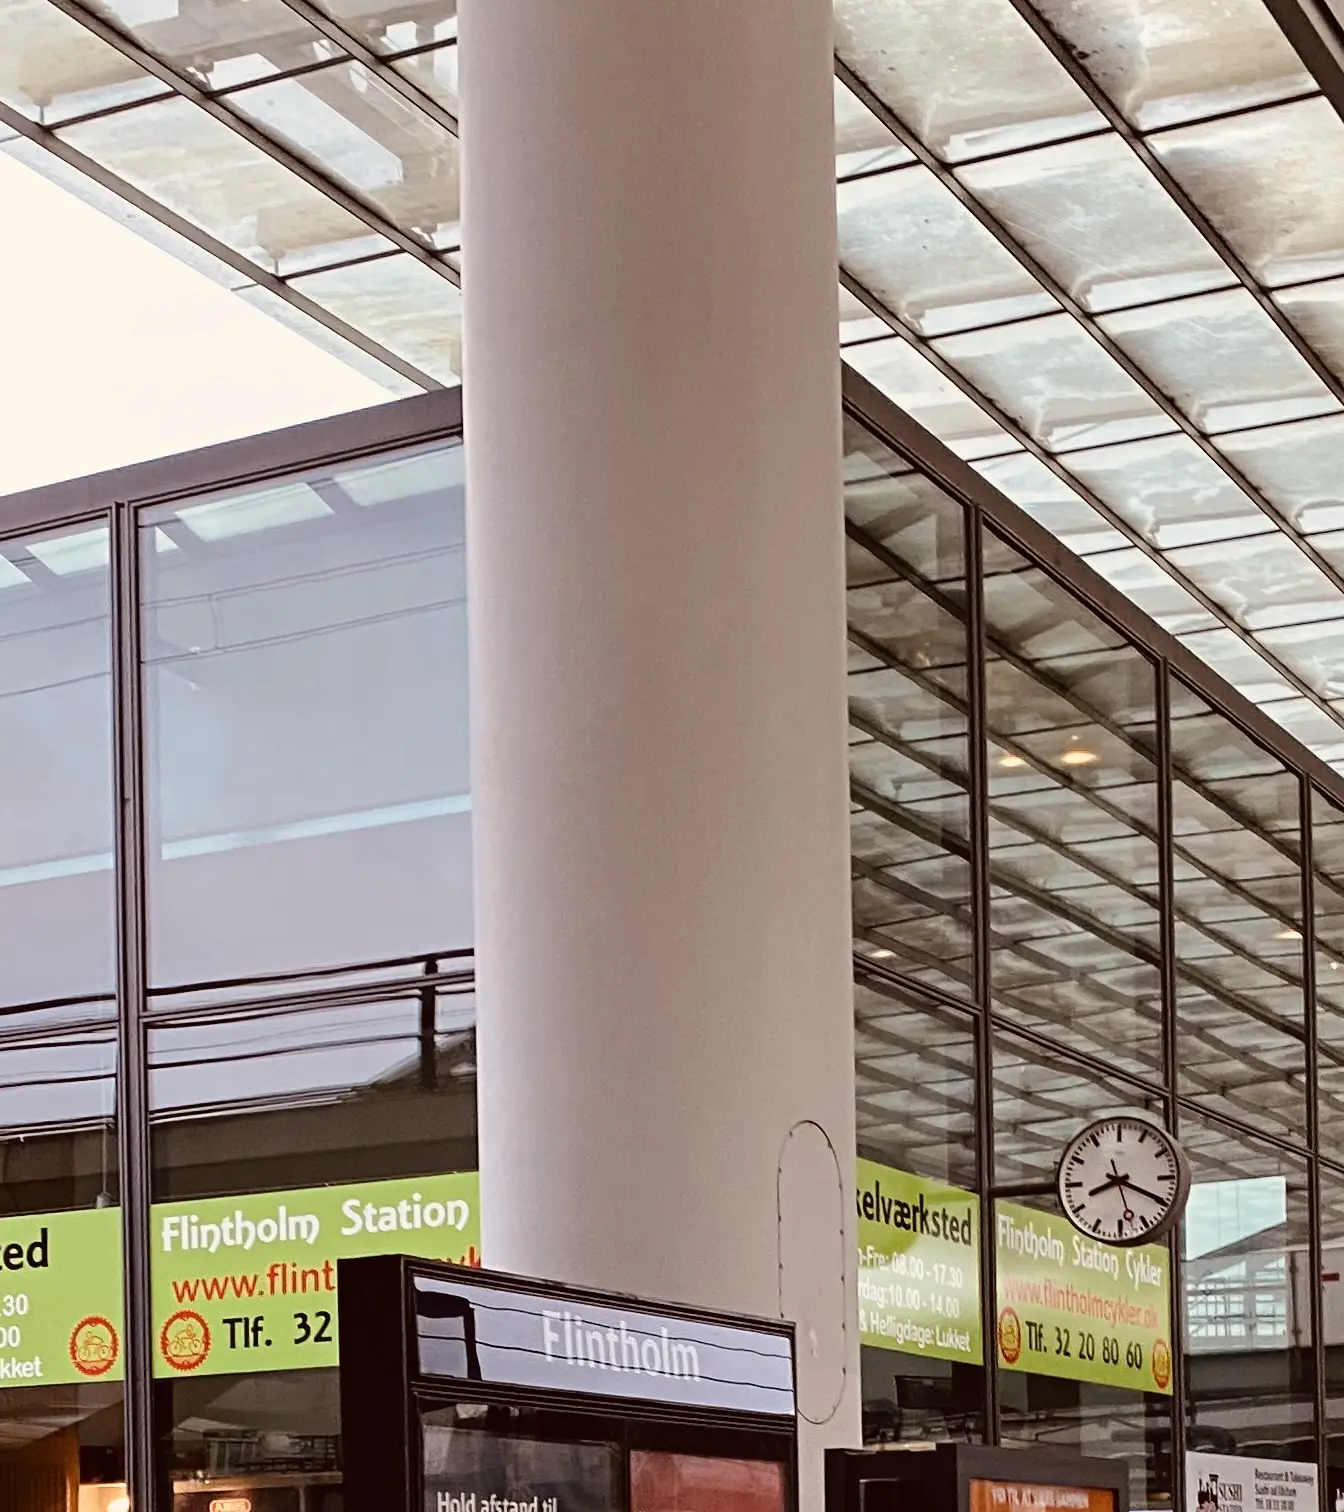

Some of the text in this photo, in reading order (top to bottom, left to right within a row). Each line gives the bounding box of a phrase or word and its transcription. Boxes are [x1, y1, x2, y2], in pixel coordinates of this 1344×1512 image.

[162, 1193, 469, 1252] Flintholm Station
[998, 1213, 1163, 1291] Flintholm Station Cykler
[933, 1263, 963, 1289] 17.30
[931, 1292, 960, 1318] 14.00
[222, 1310, 332, 1349] Tlf. 32
[542, 1309, 701, 1382] Flintholm
[870, 1311, 934, 1348] Helligdage:
[936, 1325, 971, 1352] Lukket
[1025, 1320, 1143, 1369] Tlf. 32 20 80 60
